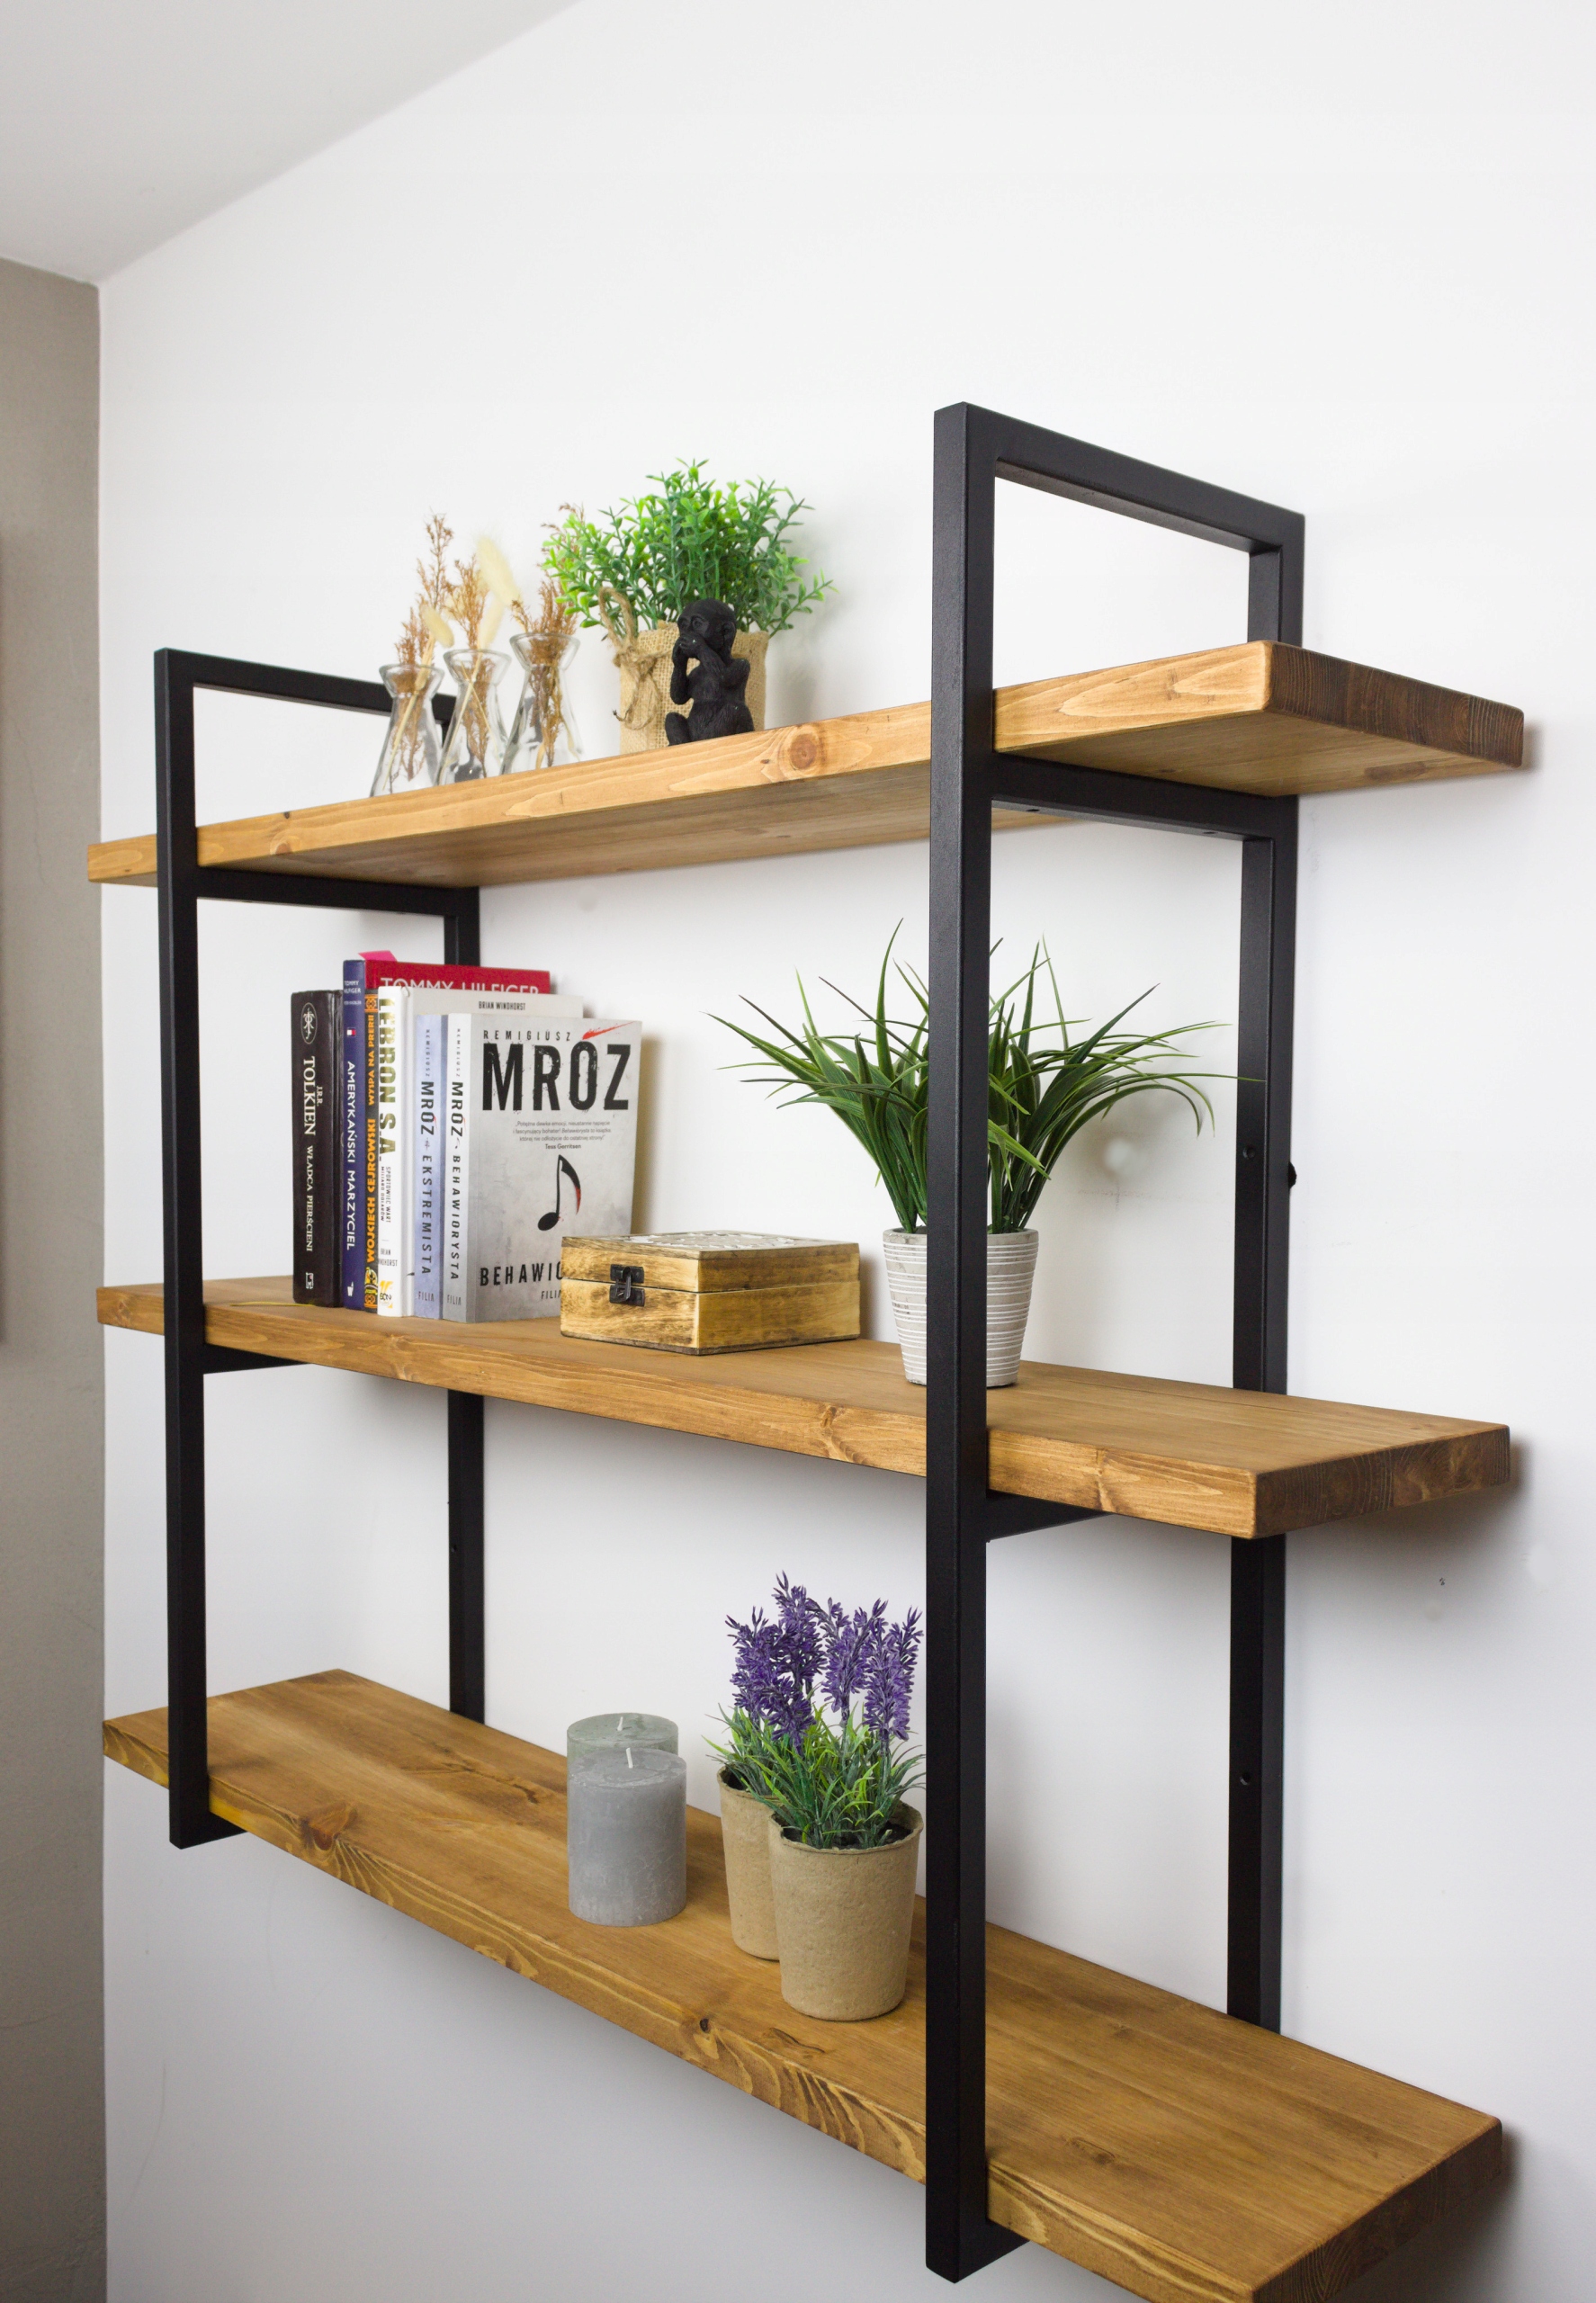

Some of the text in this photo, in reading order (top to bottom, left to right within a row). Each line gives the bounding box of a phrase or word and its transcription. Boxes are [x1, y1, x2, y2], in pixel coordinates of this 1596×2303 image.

[479, 1000, 526, 1010] BRIAN WINDHORST
[483, 1029, 570, 1042] REMIGIUSZ
[368, 1051, 375, 1067] NA
[379, 998, 396, 1103] LEBRON
[303, 1055, 316, 1135] TOLKIEN
[346, 1061, 357, 1250] AMERYKAŃSKI MARZYCIEL
[367, 1118, 376, 1193] CEJROWSKI
[306, 1145, 314, 1252] WŁADCA PIERŚCIENI
[366, 1196, 376, 1263] WOJCIECH
[421, 1154, 432, 1274] EKSTREMISTA
[451, 1155, 462, 1279] BEHAWIORYSTA
